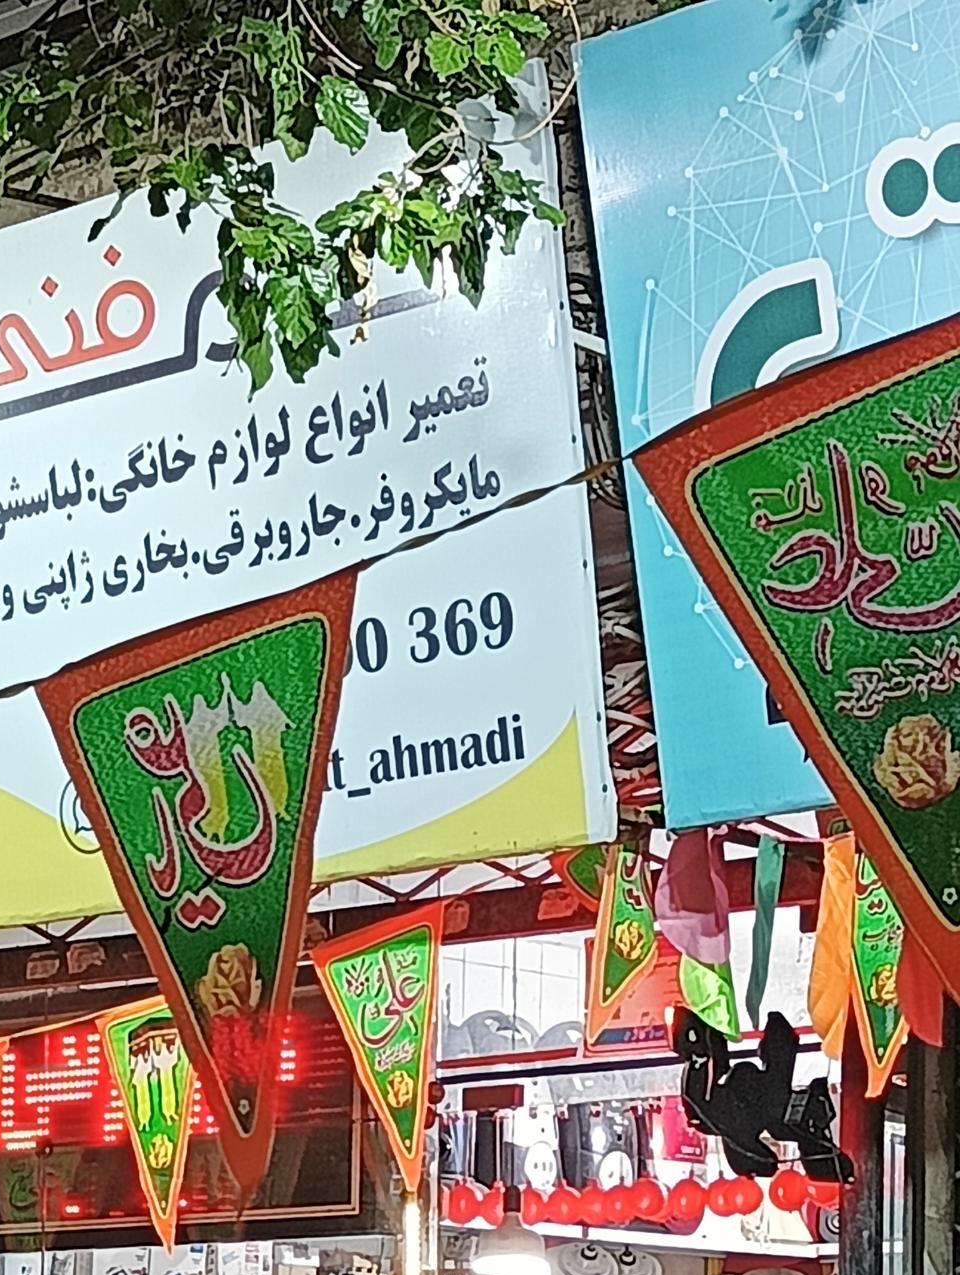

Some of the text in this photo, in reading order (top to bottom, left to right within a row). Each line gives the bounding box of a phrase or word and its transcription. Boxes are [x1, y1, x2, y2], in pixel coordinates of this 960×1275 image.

[304, 377, 390, 465] انواع
[402, 355, 490, 444] تعمیر
[207, 404, 291, 490] لوازم
[0, 583, 15, 622] و
[22, 548, 95, 616] ژاپنی
[407, 591, 515, 664] 369
[322, 713, 526, 799] t_ahmadi
